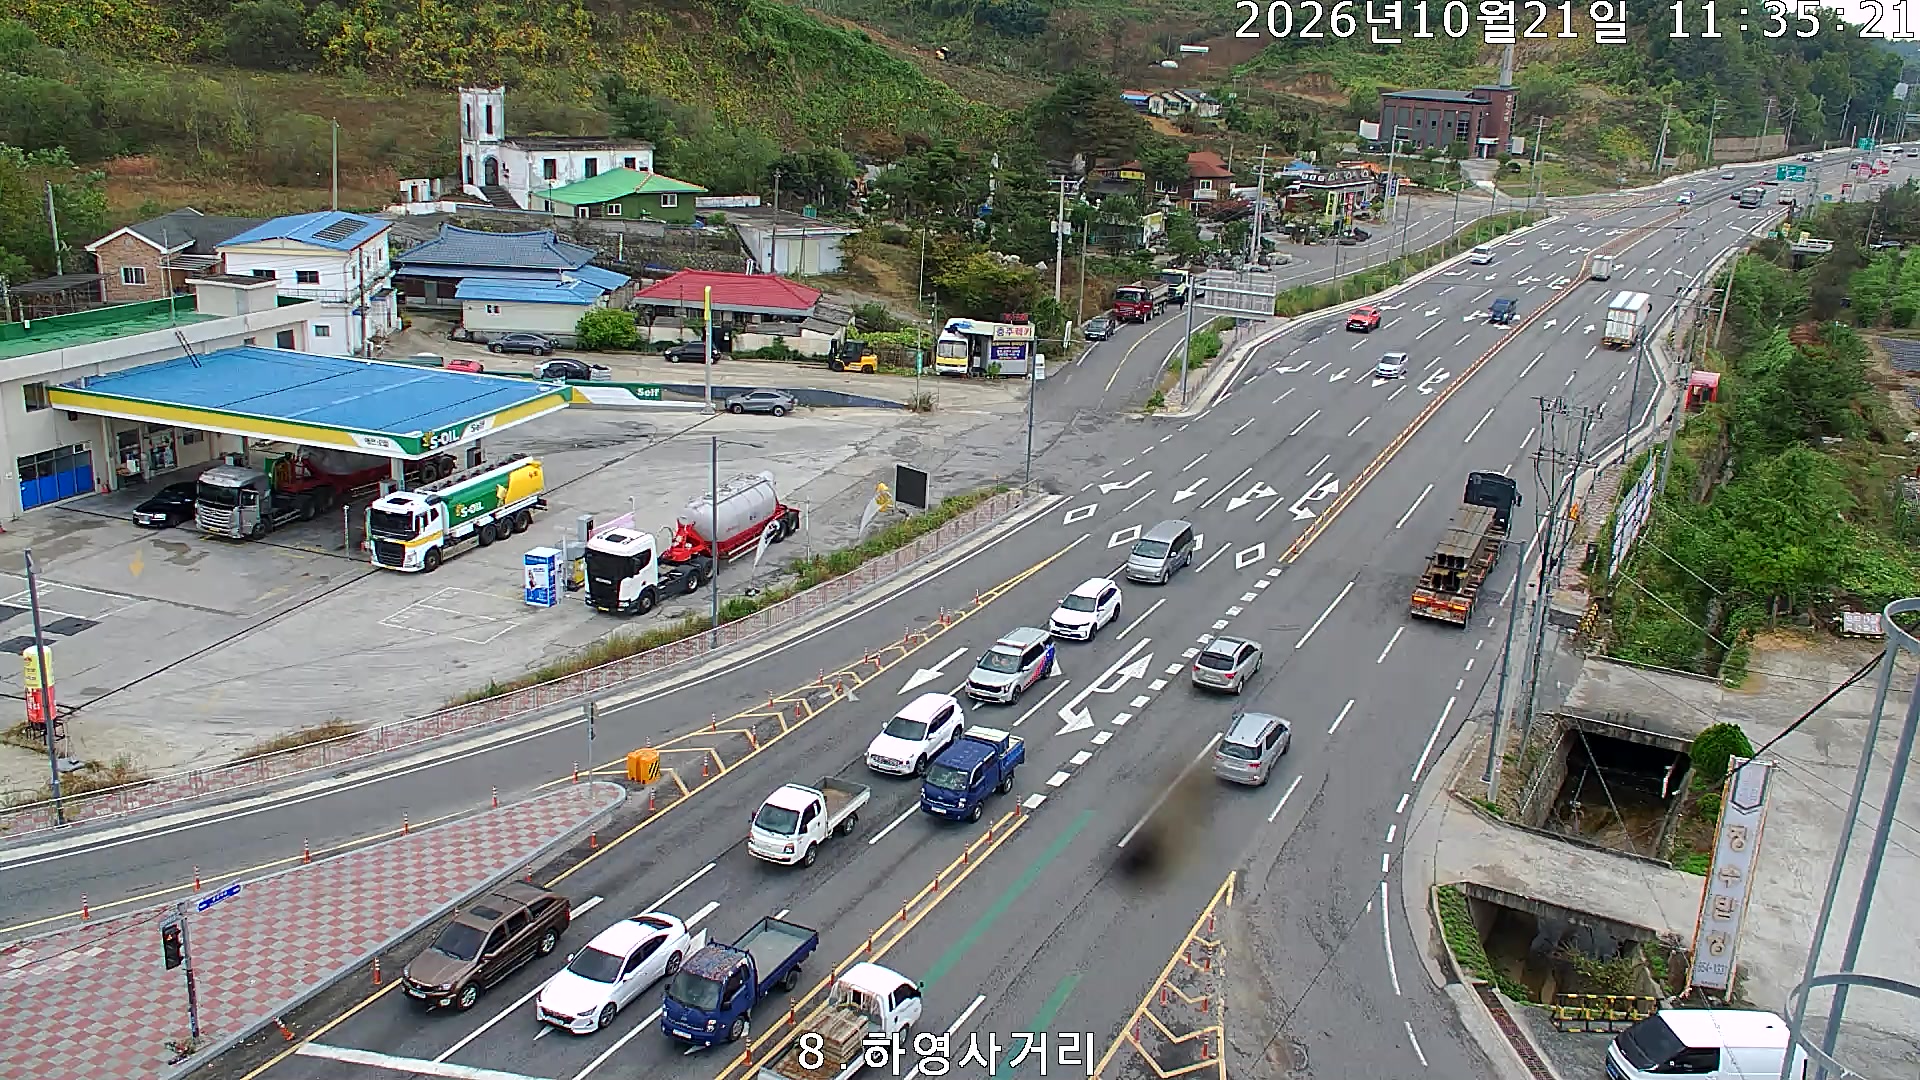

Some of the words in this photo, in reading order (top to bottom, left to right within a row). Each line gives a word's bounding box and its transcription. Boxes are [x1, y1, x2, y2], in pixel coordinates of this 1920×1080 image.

[637, 387, 660, 397] Self
[430, 429, 460, 449] S-OIL
[460, 502, 484, 517] S-OIL
